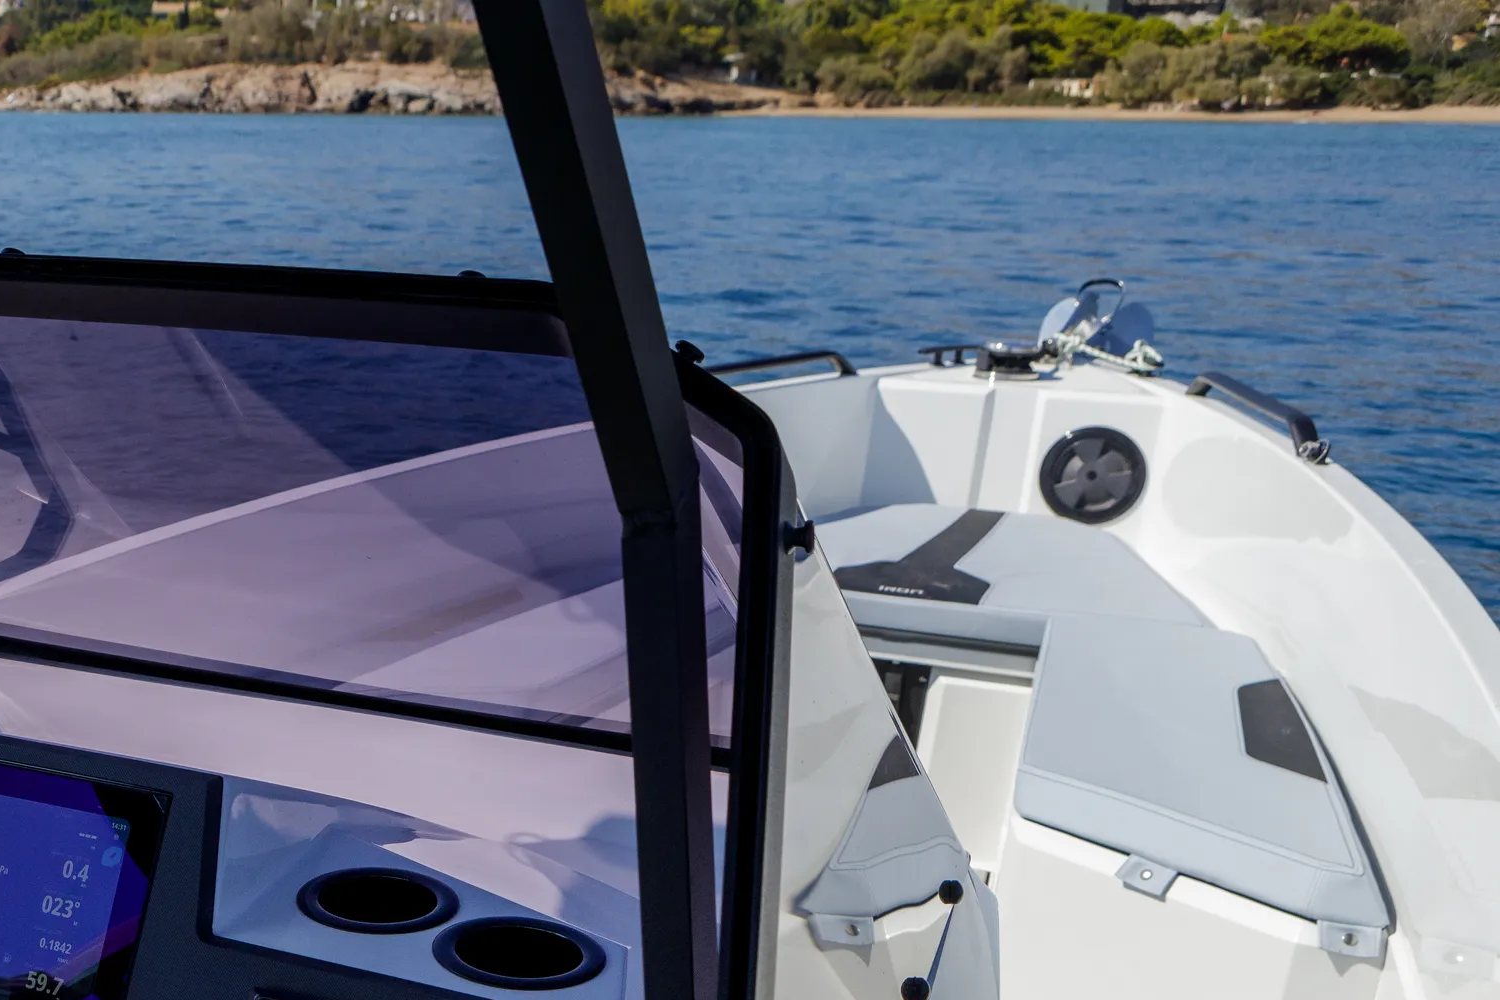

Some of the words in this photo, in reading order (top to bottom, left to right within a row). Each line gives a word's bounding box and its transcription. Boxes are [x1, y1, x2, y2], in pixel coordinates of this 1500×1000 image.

[62, 860, 90, 882] 0.4
[39, 937, 72, 955] 0.1842
[25, 970, 64, 996] 59.7
